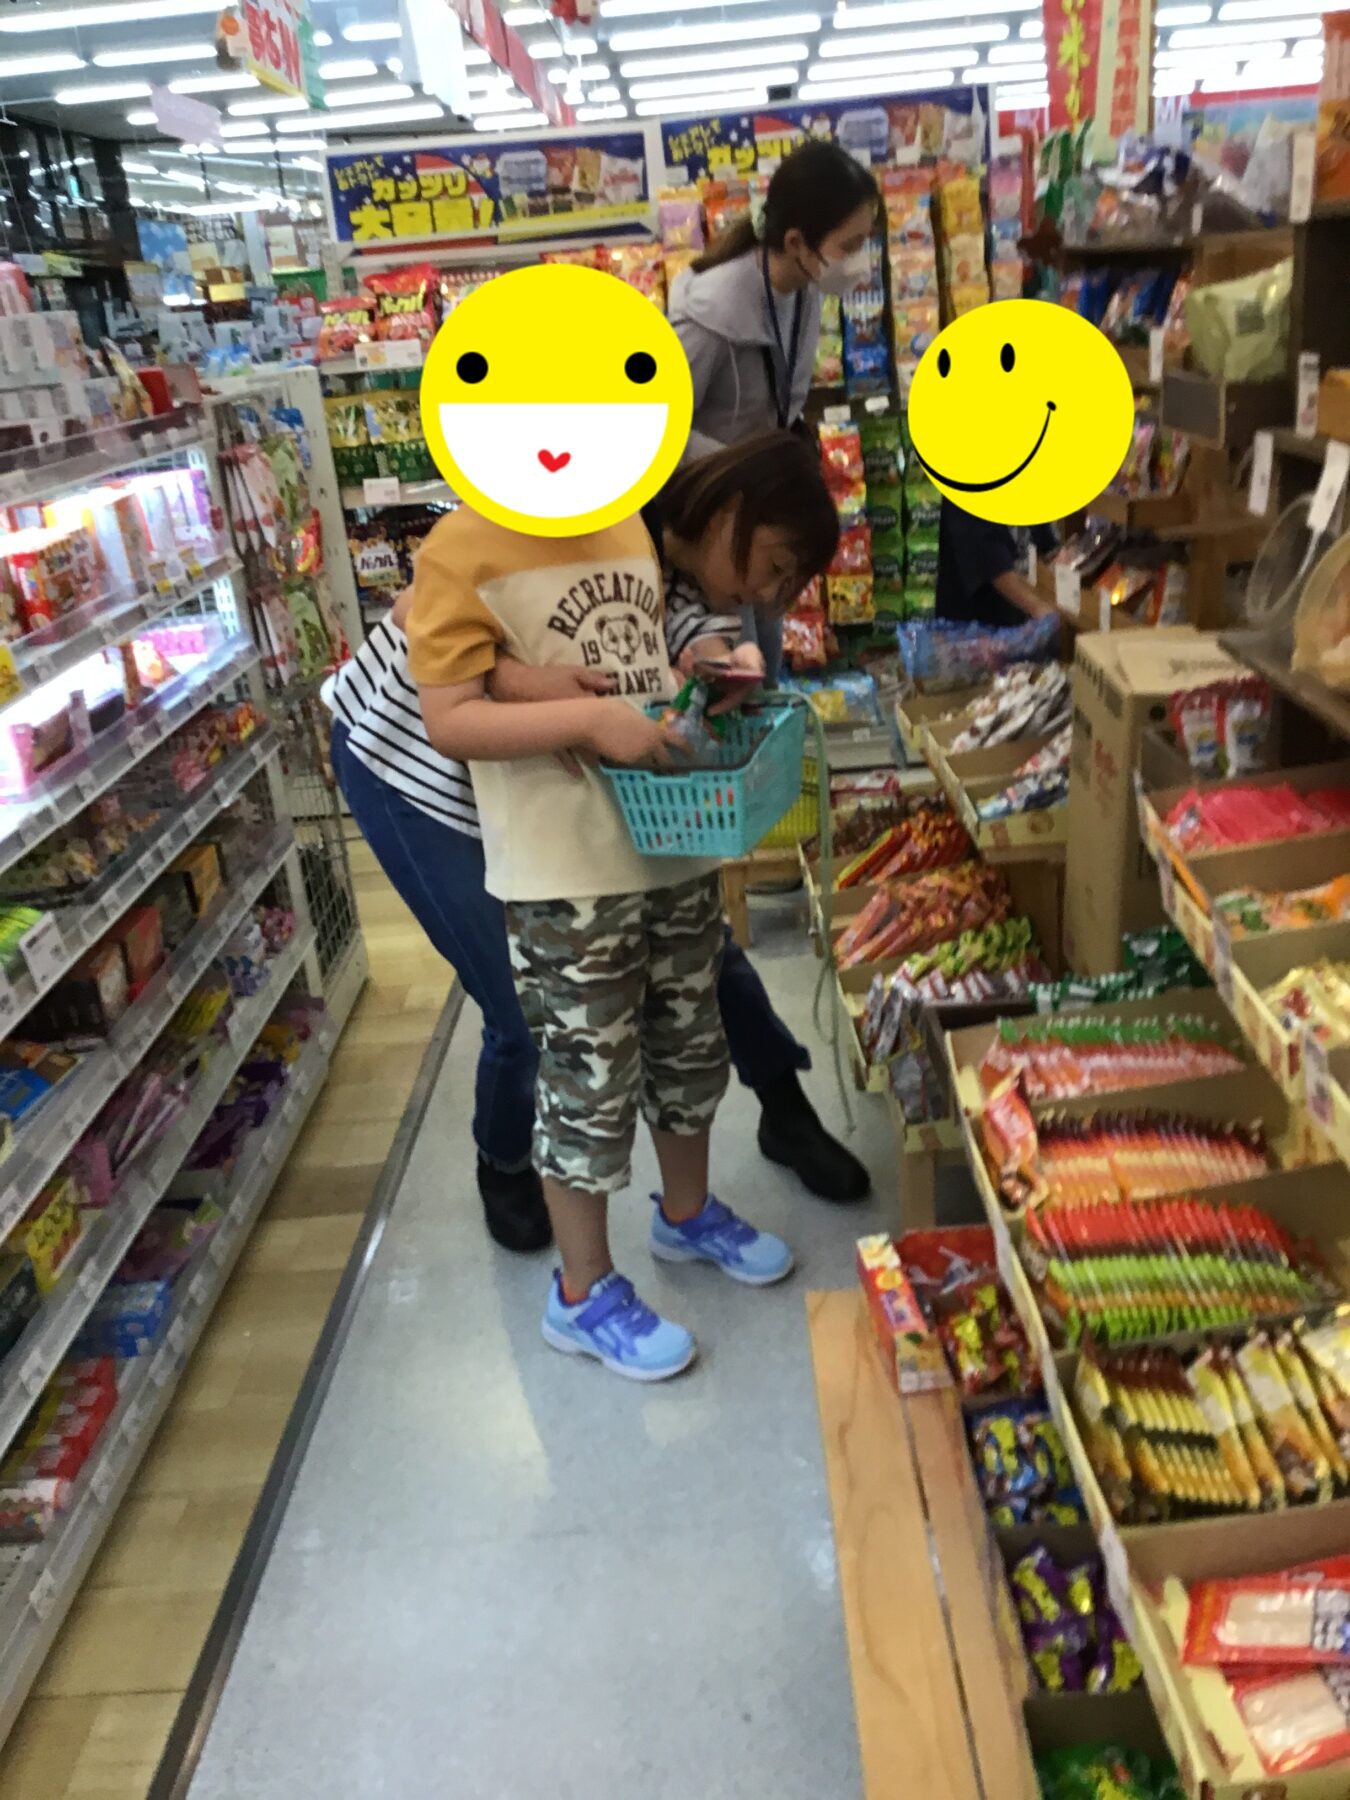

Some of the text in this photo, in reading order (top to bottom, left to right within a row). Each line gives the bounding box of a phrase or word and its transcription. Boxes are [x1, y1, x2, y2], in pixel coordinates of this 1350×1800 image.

[546, 571, 660, 640] RECREATION
[580, 640, 602, 667] 19
[594, 666, 662, 697] HAMPS
